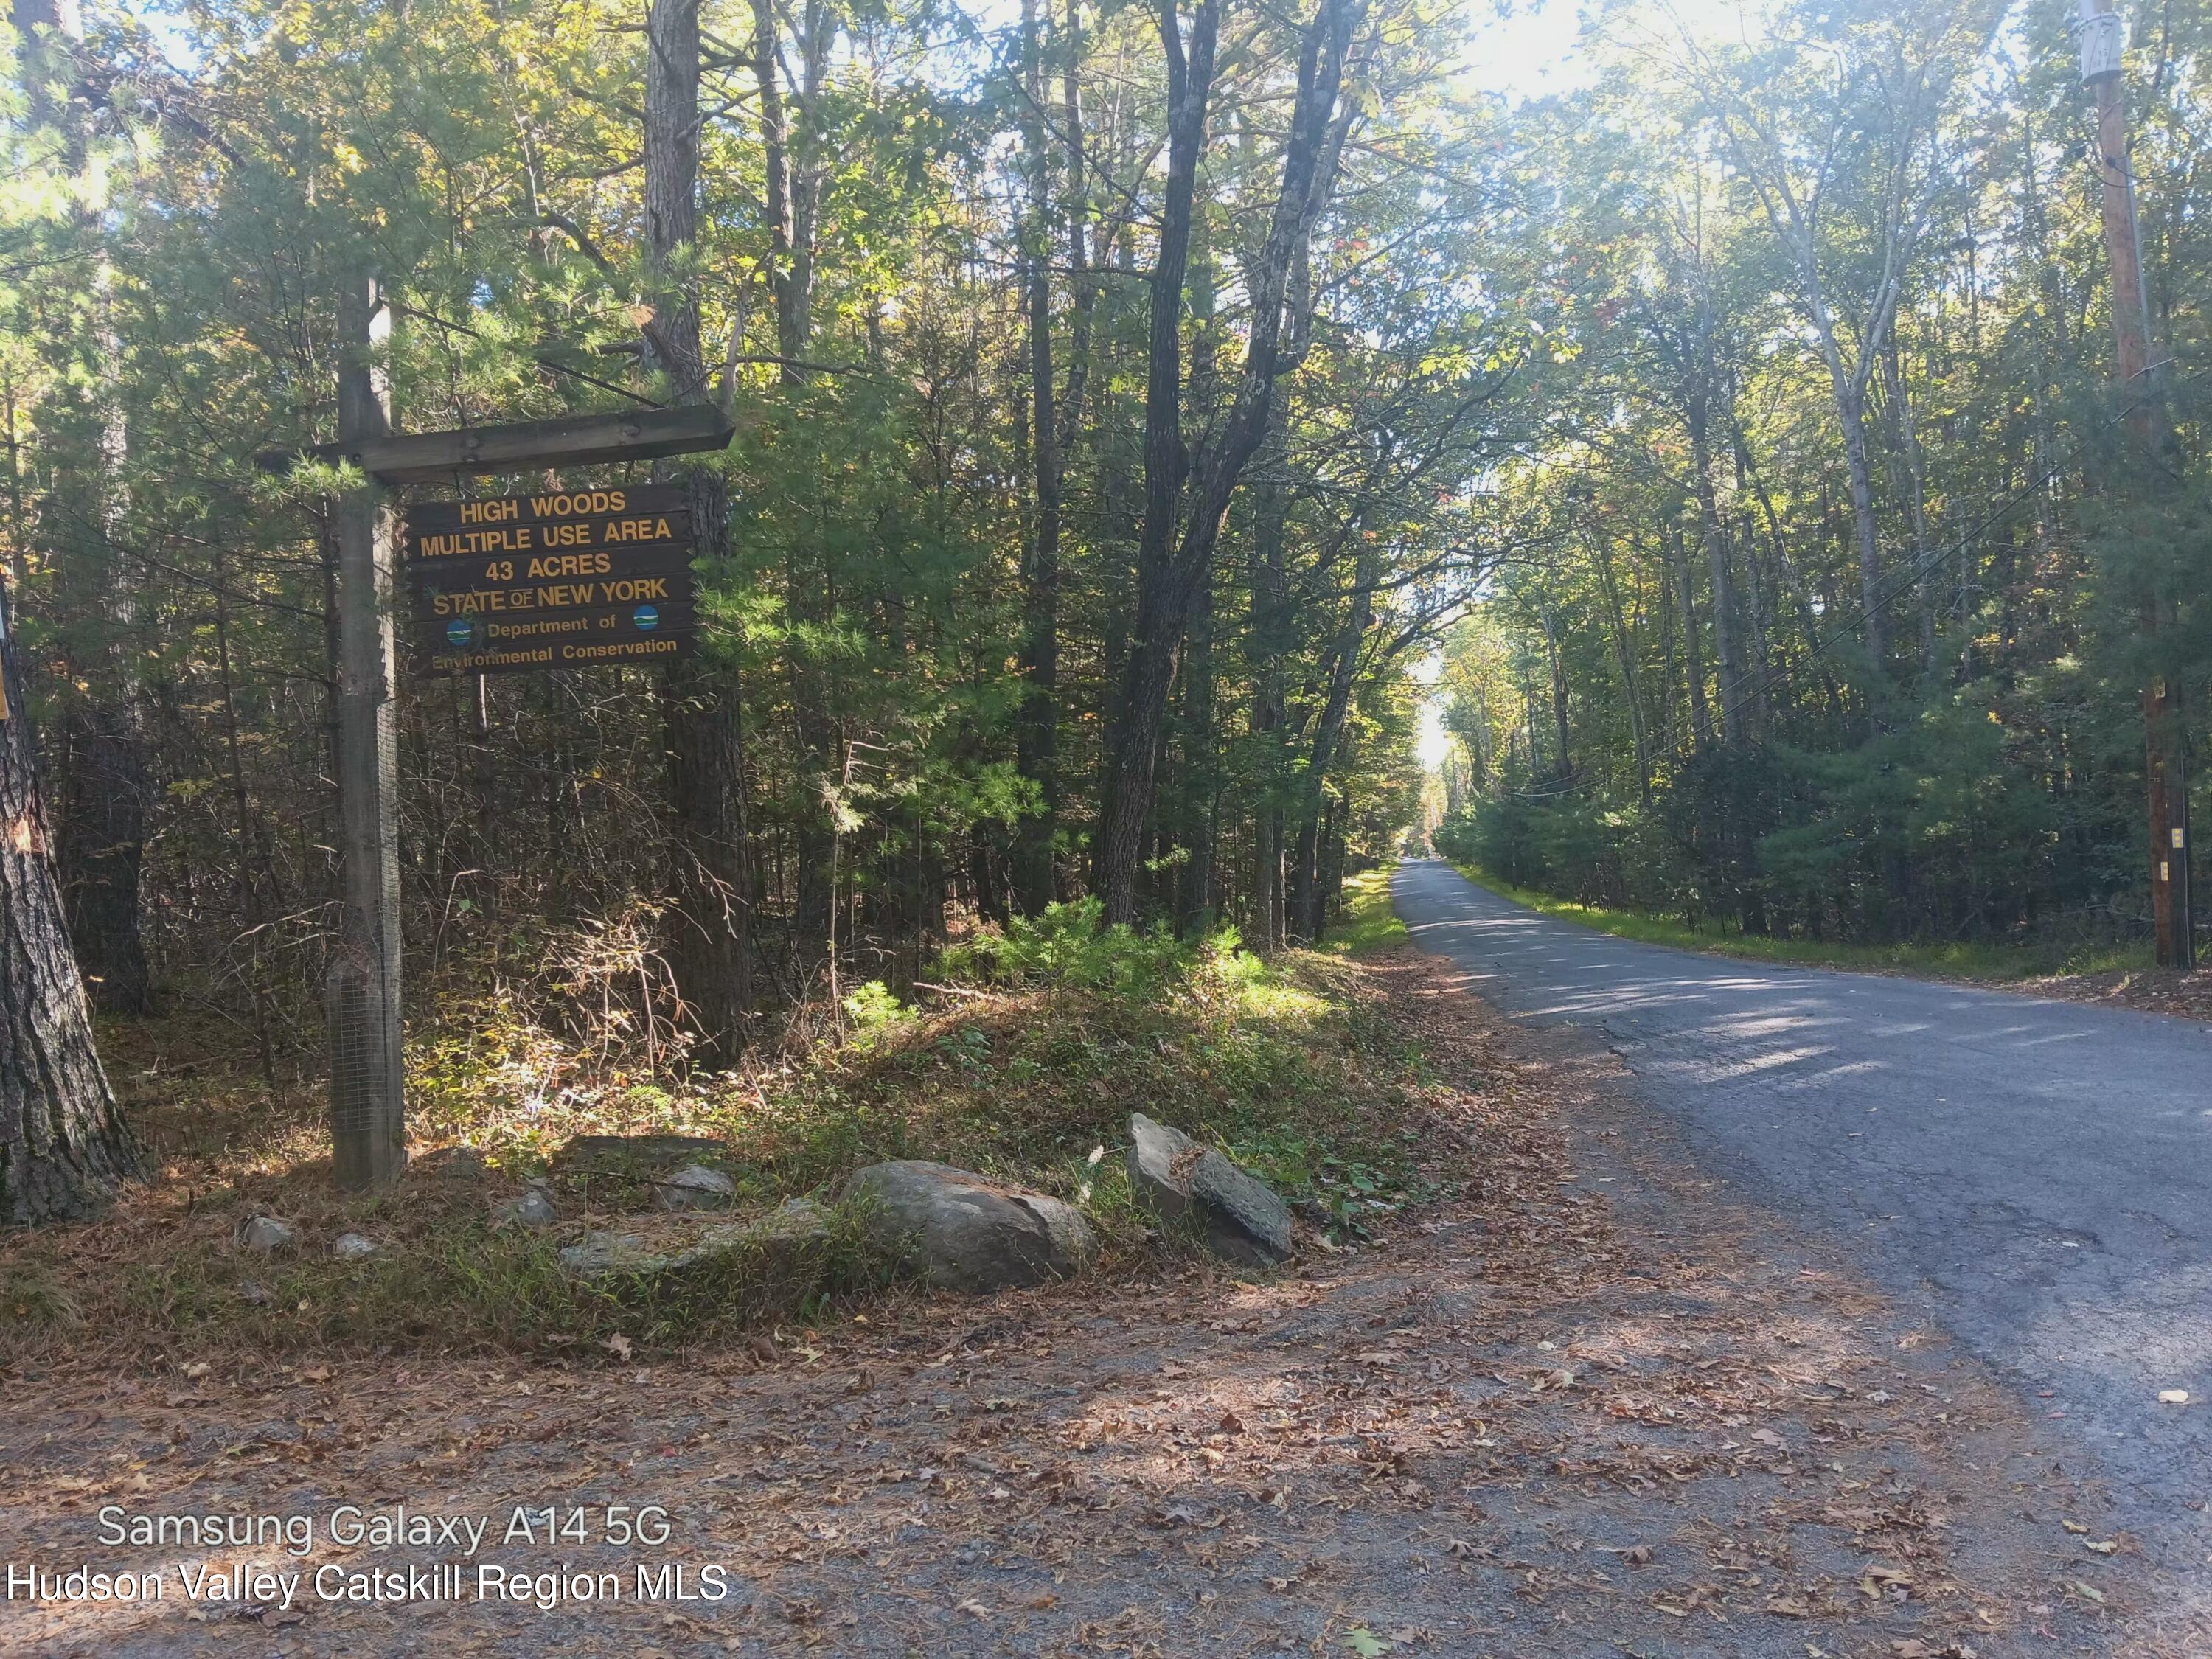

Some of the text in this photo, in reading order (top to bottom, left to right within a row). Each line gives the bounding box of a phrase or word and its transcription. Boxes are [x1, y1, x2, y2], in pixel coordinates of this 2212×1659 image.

[460, 491, 625, 524] HIGH WOODS
[420, 519, 672, 557] MULTIPLE USE AREA
[485, 553, 611, 581] 43 ACRES
[434, 578, 669, 615] STATE OF NEW YORK
[488, 614, 616, 639] Department of
[433, 639, 677, 669] Environmental Conservation
